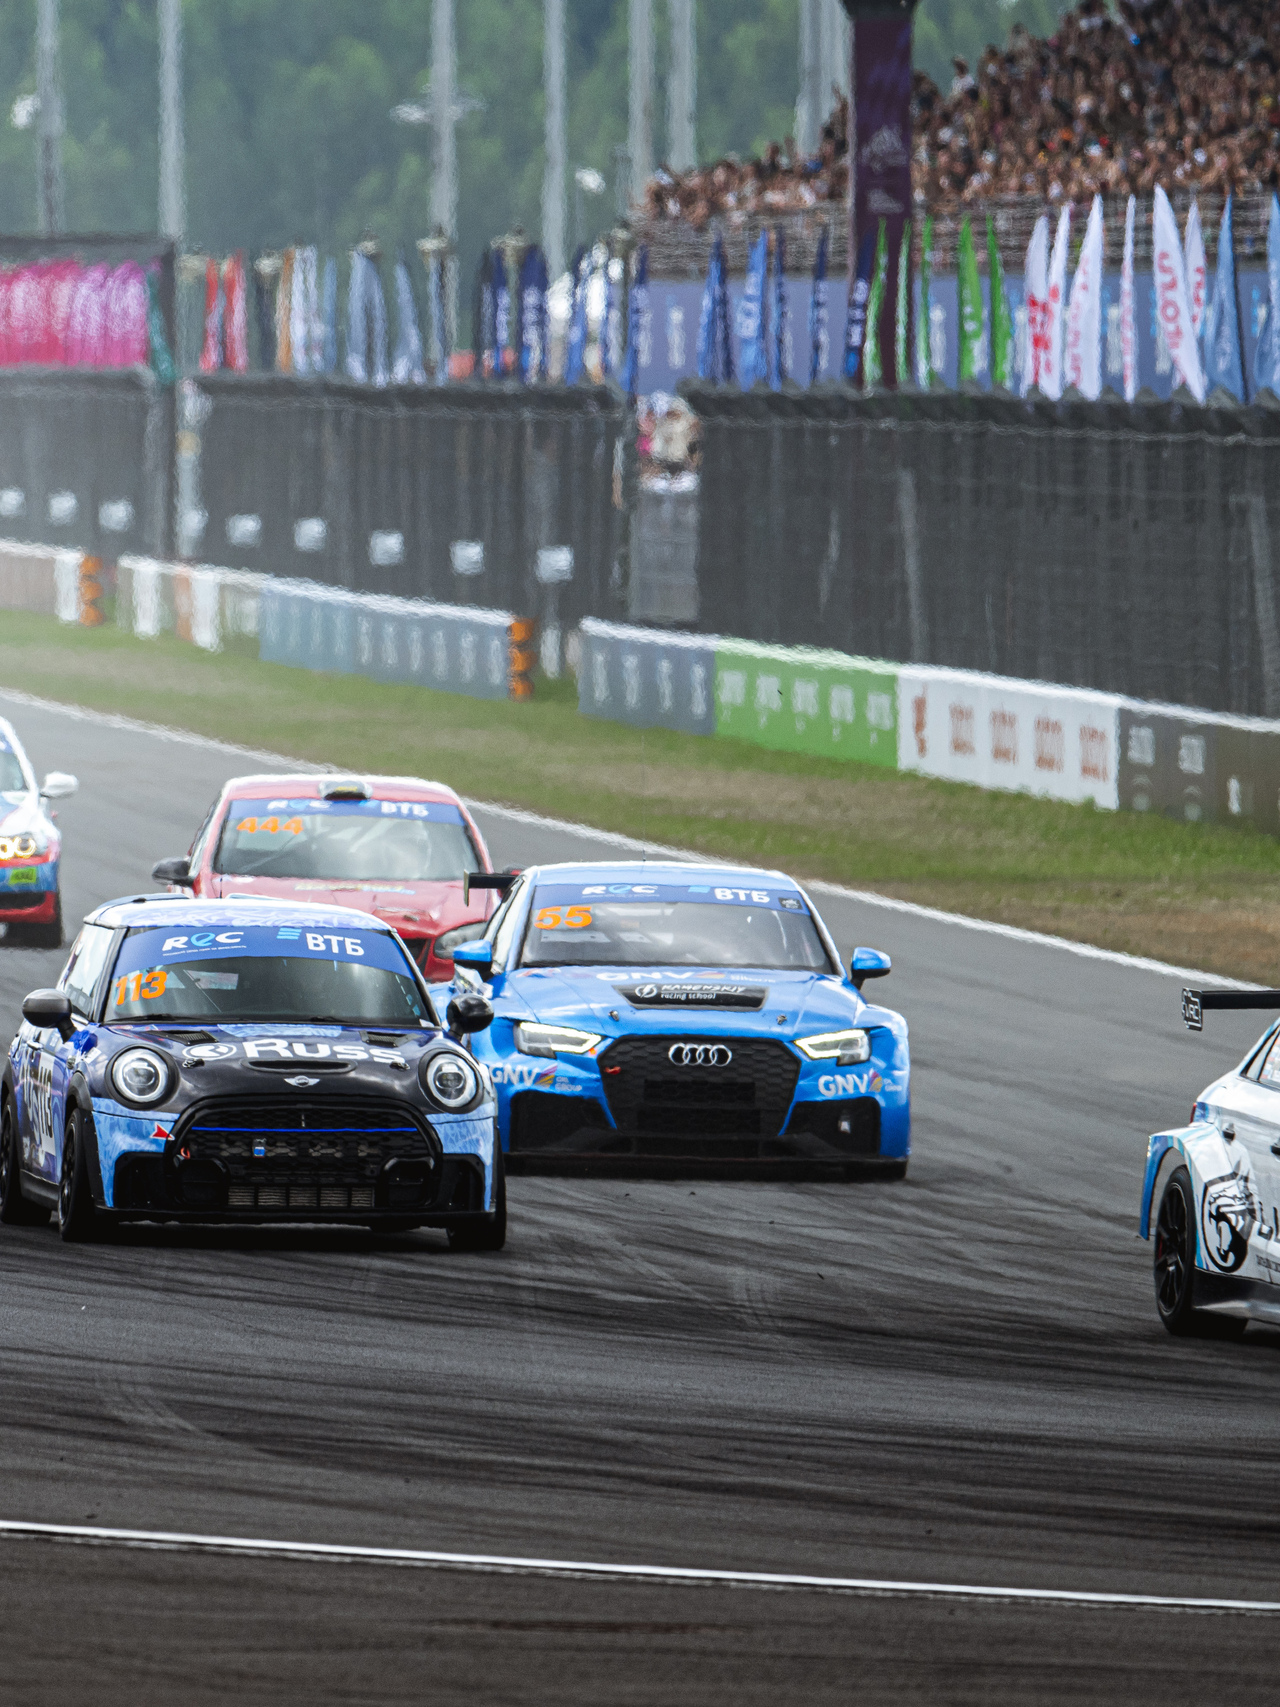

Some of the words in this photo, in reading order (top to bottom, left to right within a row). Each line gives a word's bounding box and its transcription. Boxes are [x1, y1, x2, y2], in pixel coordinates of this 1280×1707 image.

[381, 801, 429, 817] ВТБ
[236, 817, 304, 835] 444
[714, 887, 770, 903] ВТБ
[534, 906, 592, 929] 55
[306, 933, 365, 956] ВТБ
[596, 971, 695, 981] GNV
[116, 971, 168, 1005] 113
[661, 984, 746, 993] KAMENSKIY
[661, 993, 686, 1001] racing
[688, 992, 717, 1000] school
[489, 1062, 540, 1087] GNV
[818, 1073, 868, 1097] GNV
